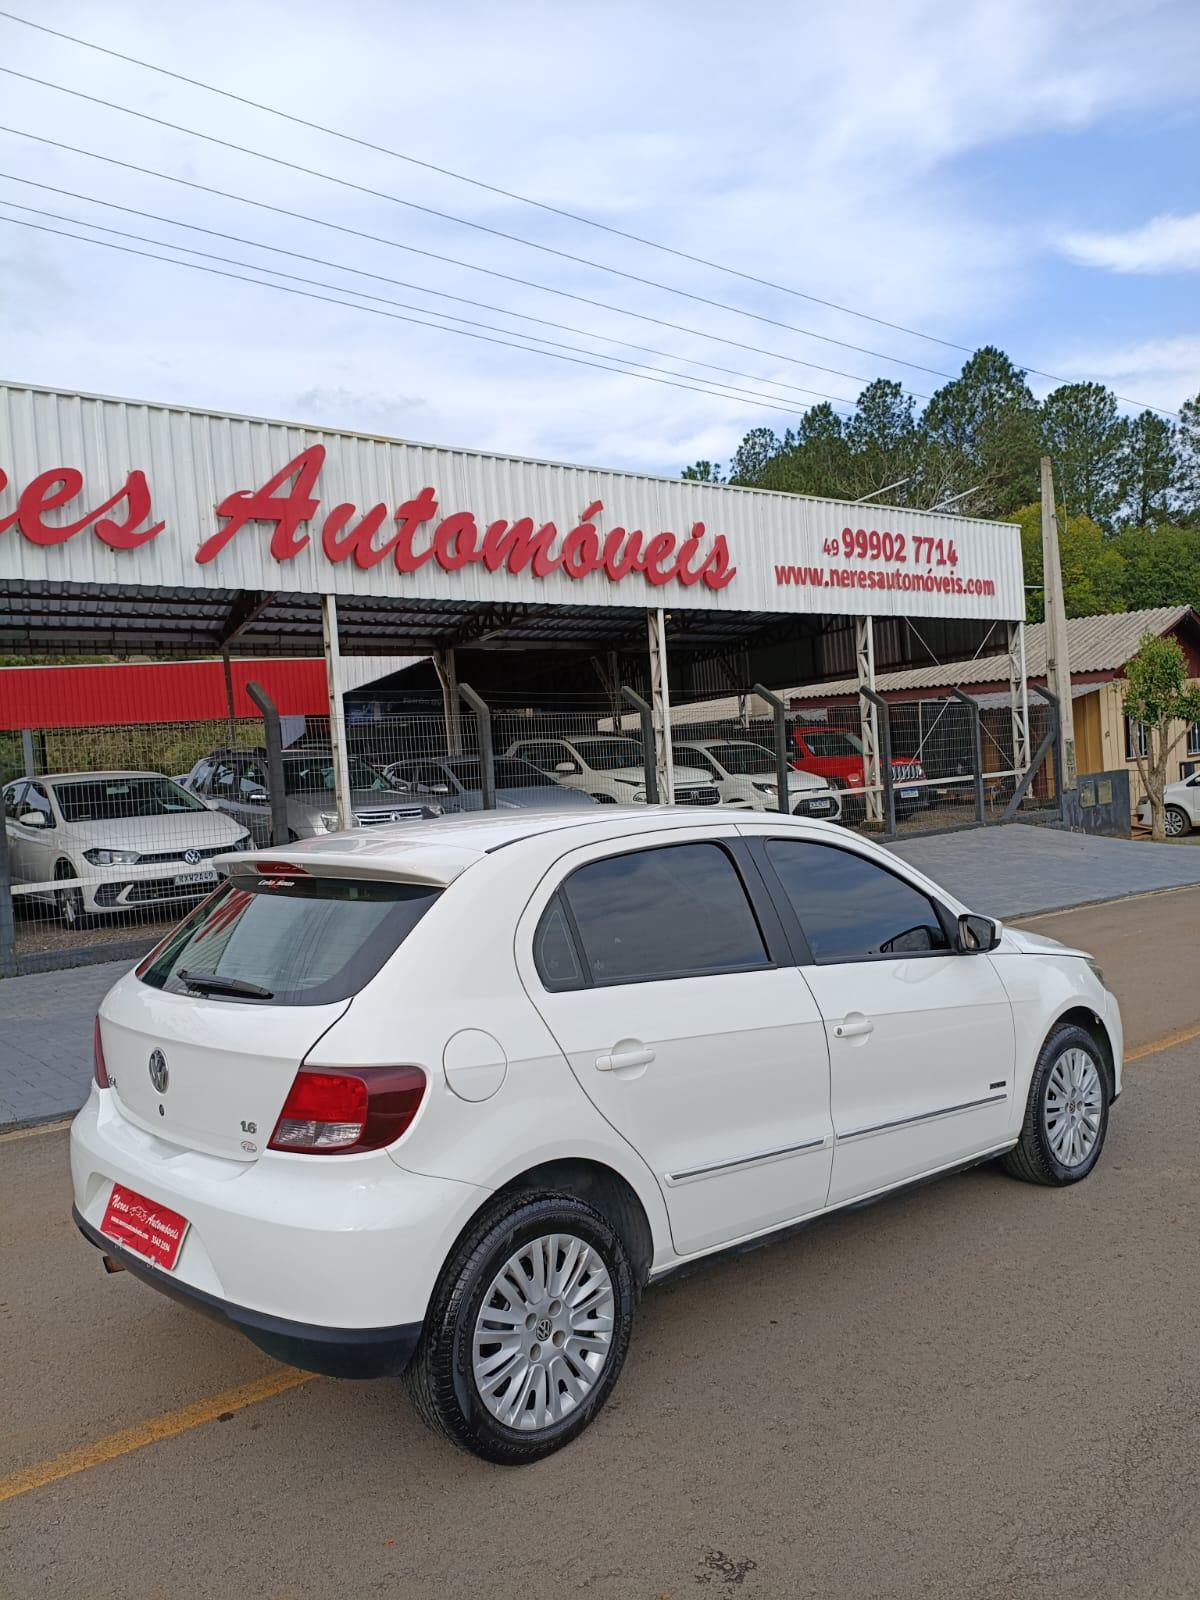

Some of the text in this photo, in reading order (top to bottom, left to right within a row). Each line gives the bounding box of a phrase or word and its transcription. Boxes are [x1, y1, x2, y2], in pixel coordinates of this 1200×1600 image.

[195, 444, 736, 590] Automóveis
[822, 527, 958, 566] 49 99902 7714
[774, 564, 995, 596] www.neresautomóveis.com
